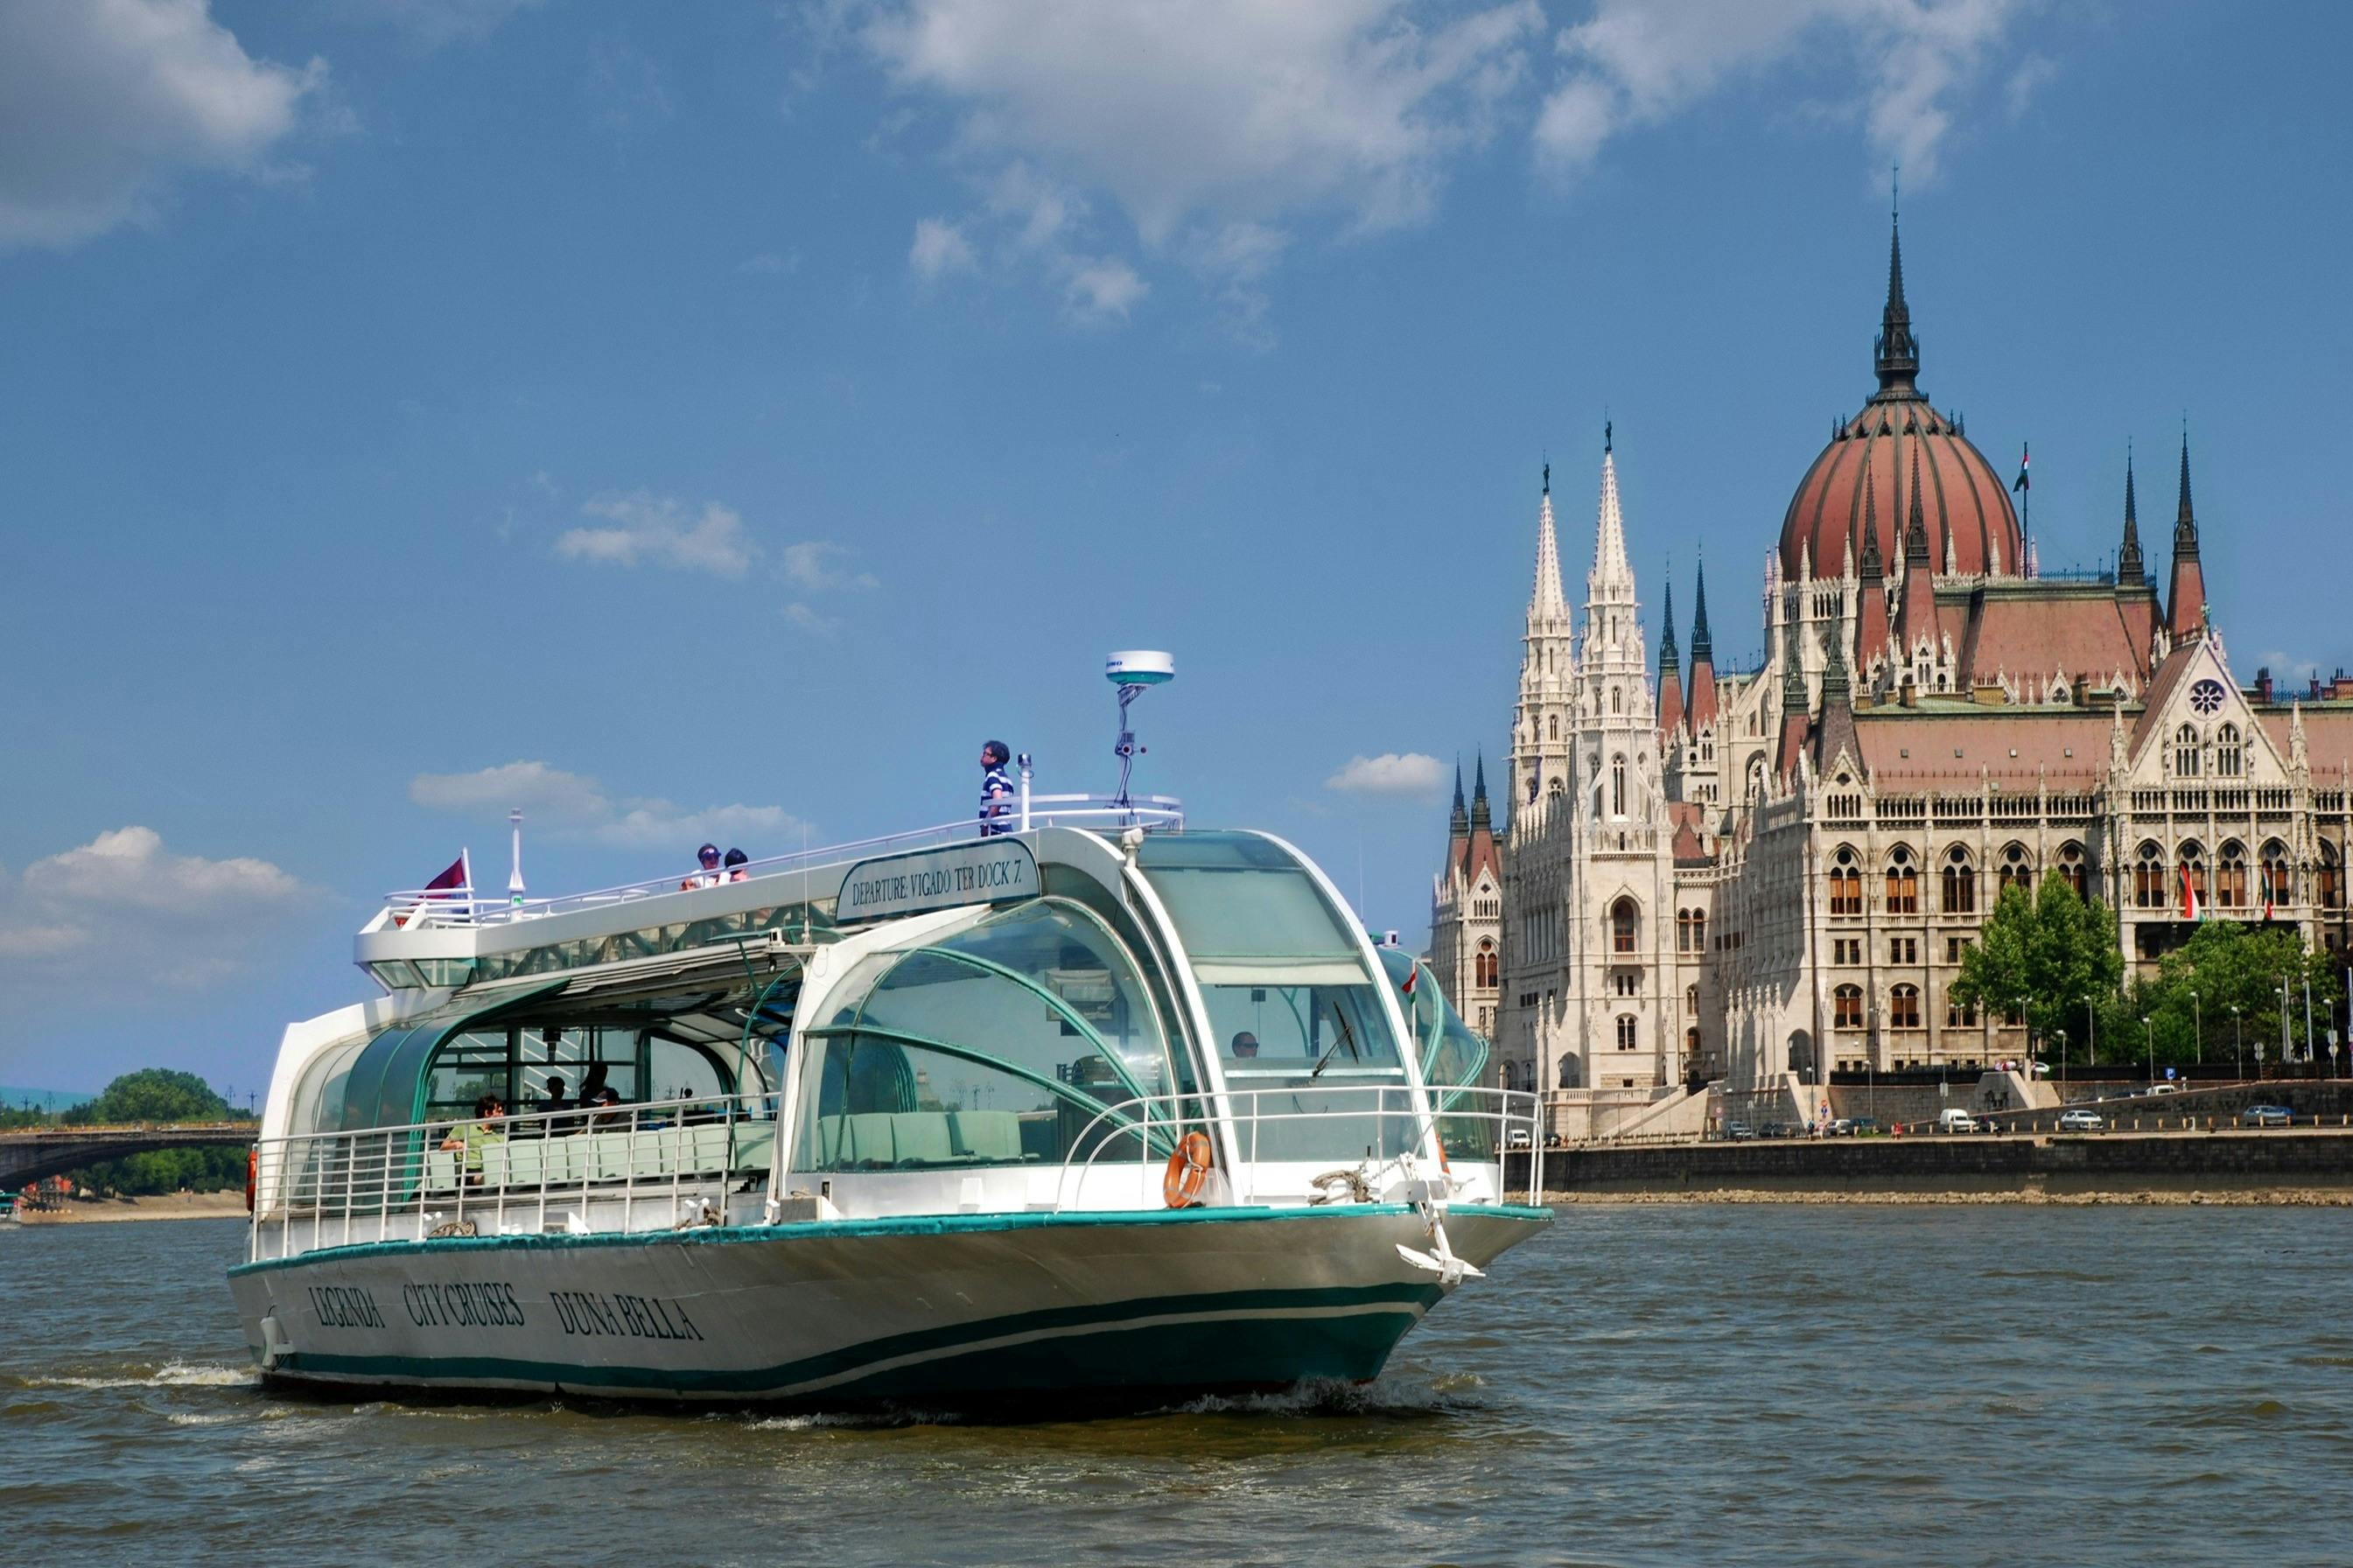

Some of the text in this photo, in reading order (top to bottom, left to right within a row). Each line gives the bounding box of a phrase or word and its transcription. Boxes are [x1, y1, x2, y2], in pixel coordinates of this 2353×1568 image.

[852, 876, 908, 906] DEPARTURE:
[910, 864, 951, 898] VIGADÓ
[955, 861, 975, 892] TÉR
[978, 861, 1010, 889] DOCK
[308, 1283, 525, 1328] LEGENDA CITY CRUISES
